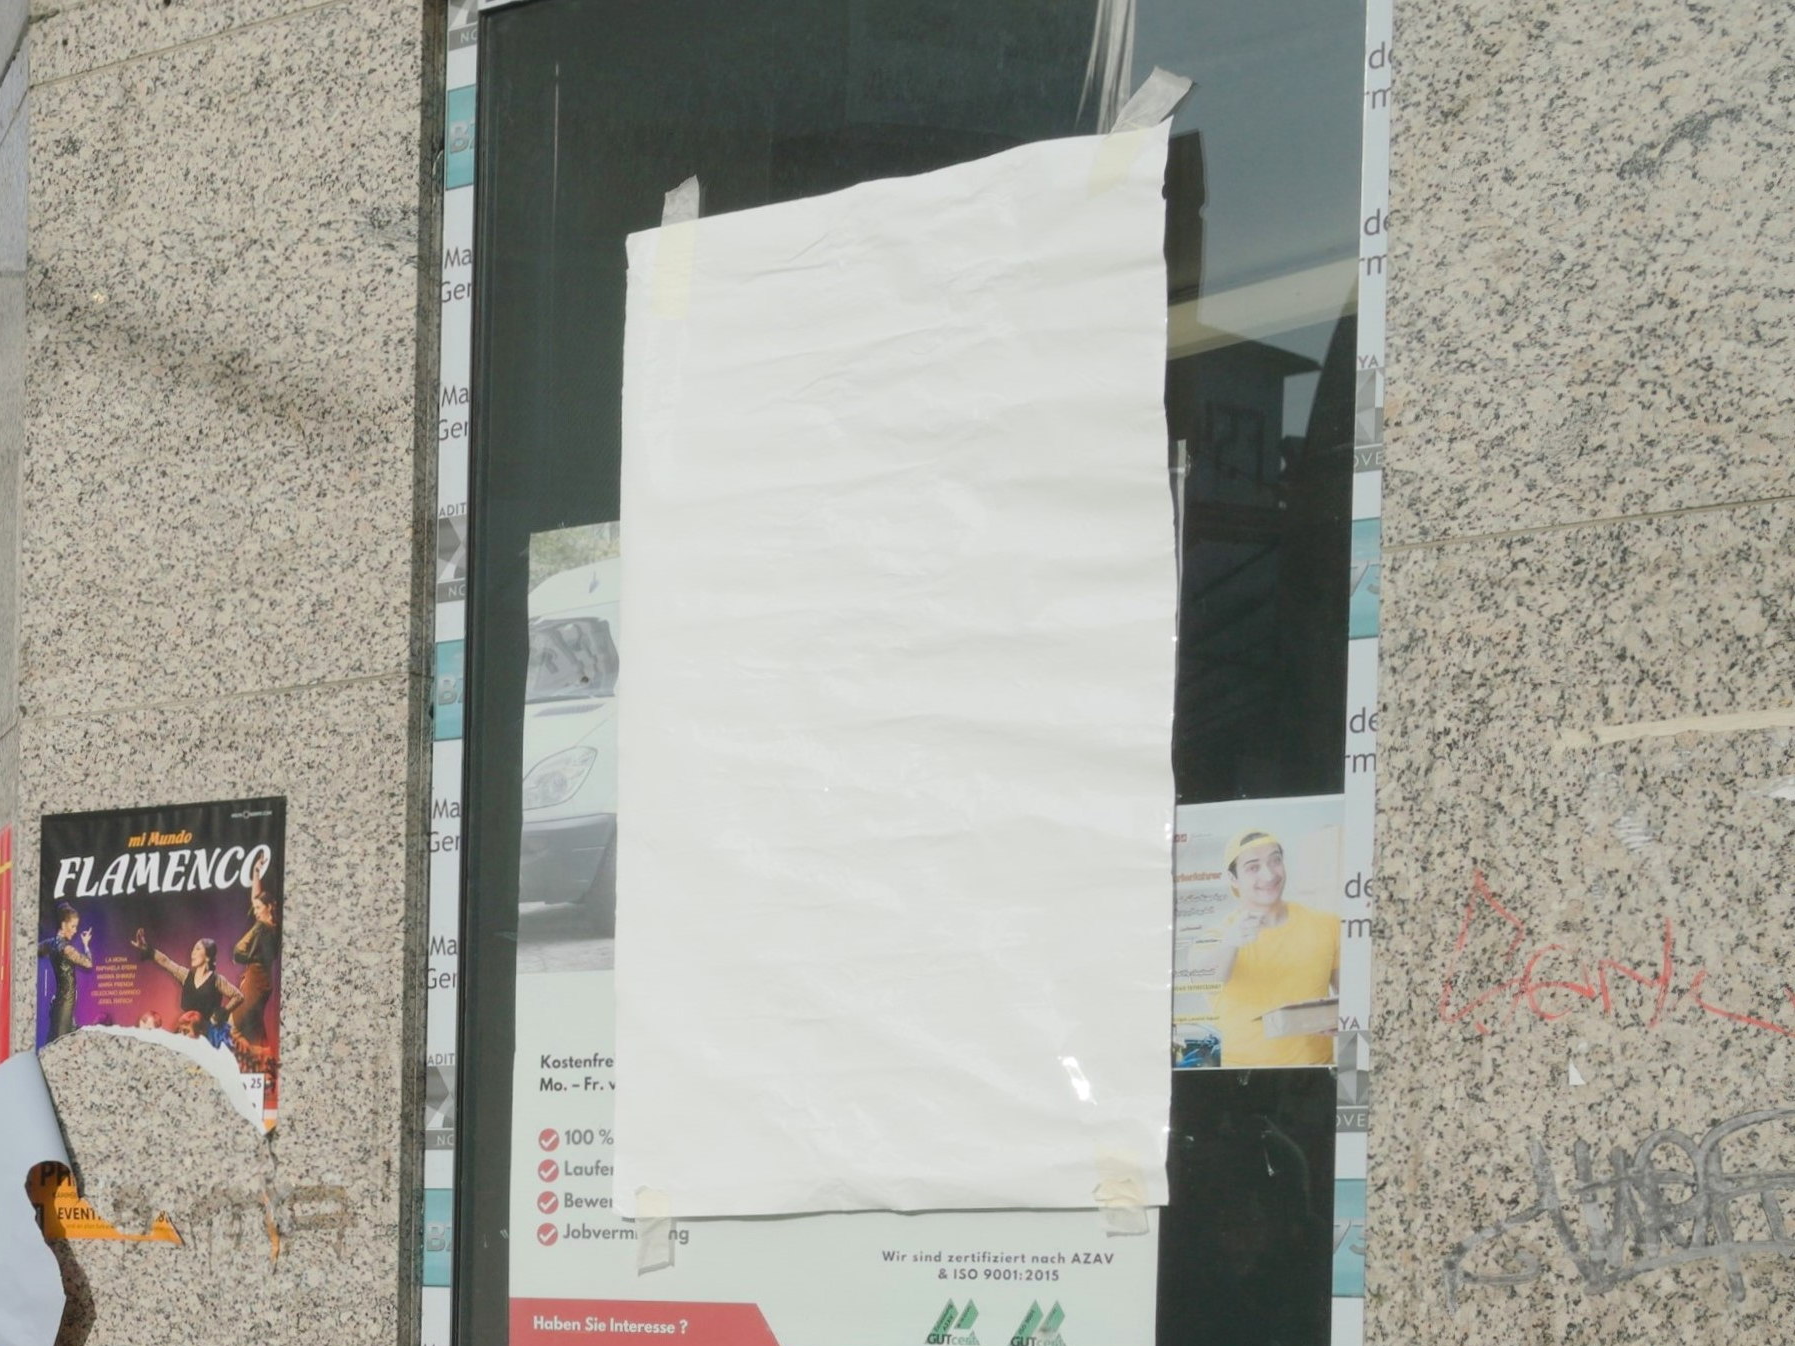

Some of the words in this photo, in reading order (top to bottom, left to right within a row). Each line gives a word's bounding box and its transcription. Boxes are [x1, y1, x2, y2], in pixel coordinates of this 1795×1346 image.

[128, 833, 145, 848] mi
[148, 829, 193, 847] Mundo
[54, 843, 272, 899] FLAMENCO
[540, 1053, 614, 1069] Kostenfre
[251, 1077, 262, 1089] 25
[539, 1077, 567, 1092] Mo.
[584, 1076, 604, 1091] Fr.
[565, 1129, 594, 1145] 100
[599, 1129, 614, 1145] %
[882, 1251, 906, 1262] Wir
[912, 1251, 942, 1263] sind
[947, 1252, 1026, 1264] zertifiziert
[1031, 1253, 1066, 1264] nach
[1071, 1253, 1115, 1264] AZAV
[938, 1269, 948, 1280] &
[954, 1269, 978, 1280] ISO
[984, 1269, 1059, 1281] 9001:2015
[533, 1316, 581, 1331] Haben
[585, 1317, 606, 1331] Sie
[610, 1318, 676, 1334] Interesse
